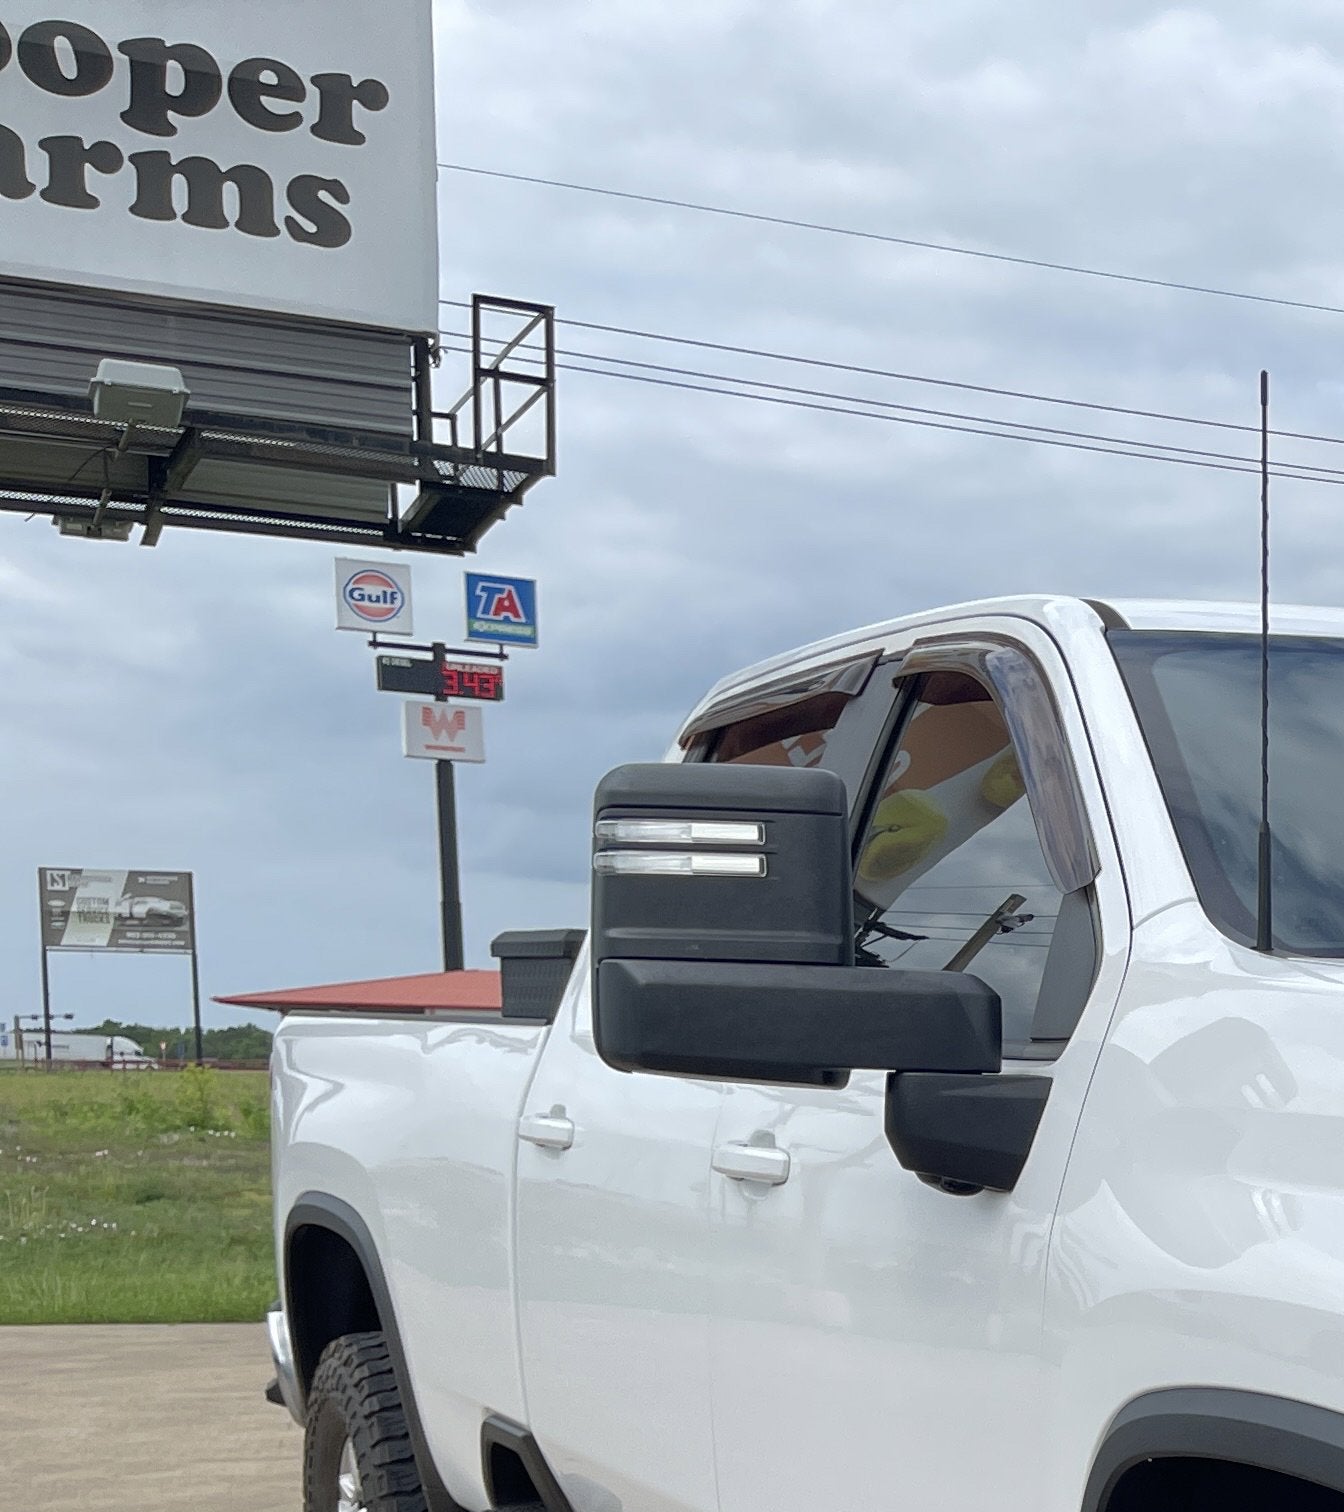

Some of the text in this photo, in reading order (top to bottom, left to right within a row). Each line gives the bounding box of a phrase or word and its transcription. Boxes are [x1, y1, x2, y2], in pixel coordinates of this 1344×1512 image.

[0, 19, 389, 146] oper
[348, 586, 399, 605] Gulf
[476, 581, 526, 623] TA
[446, 663, 498, 675] UNLEADED
